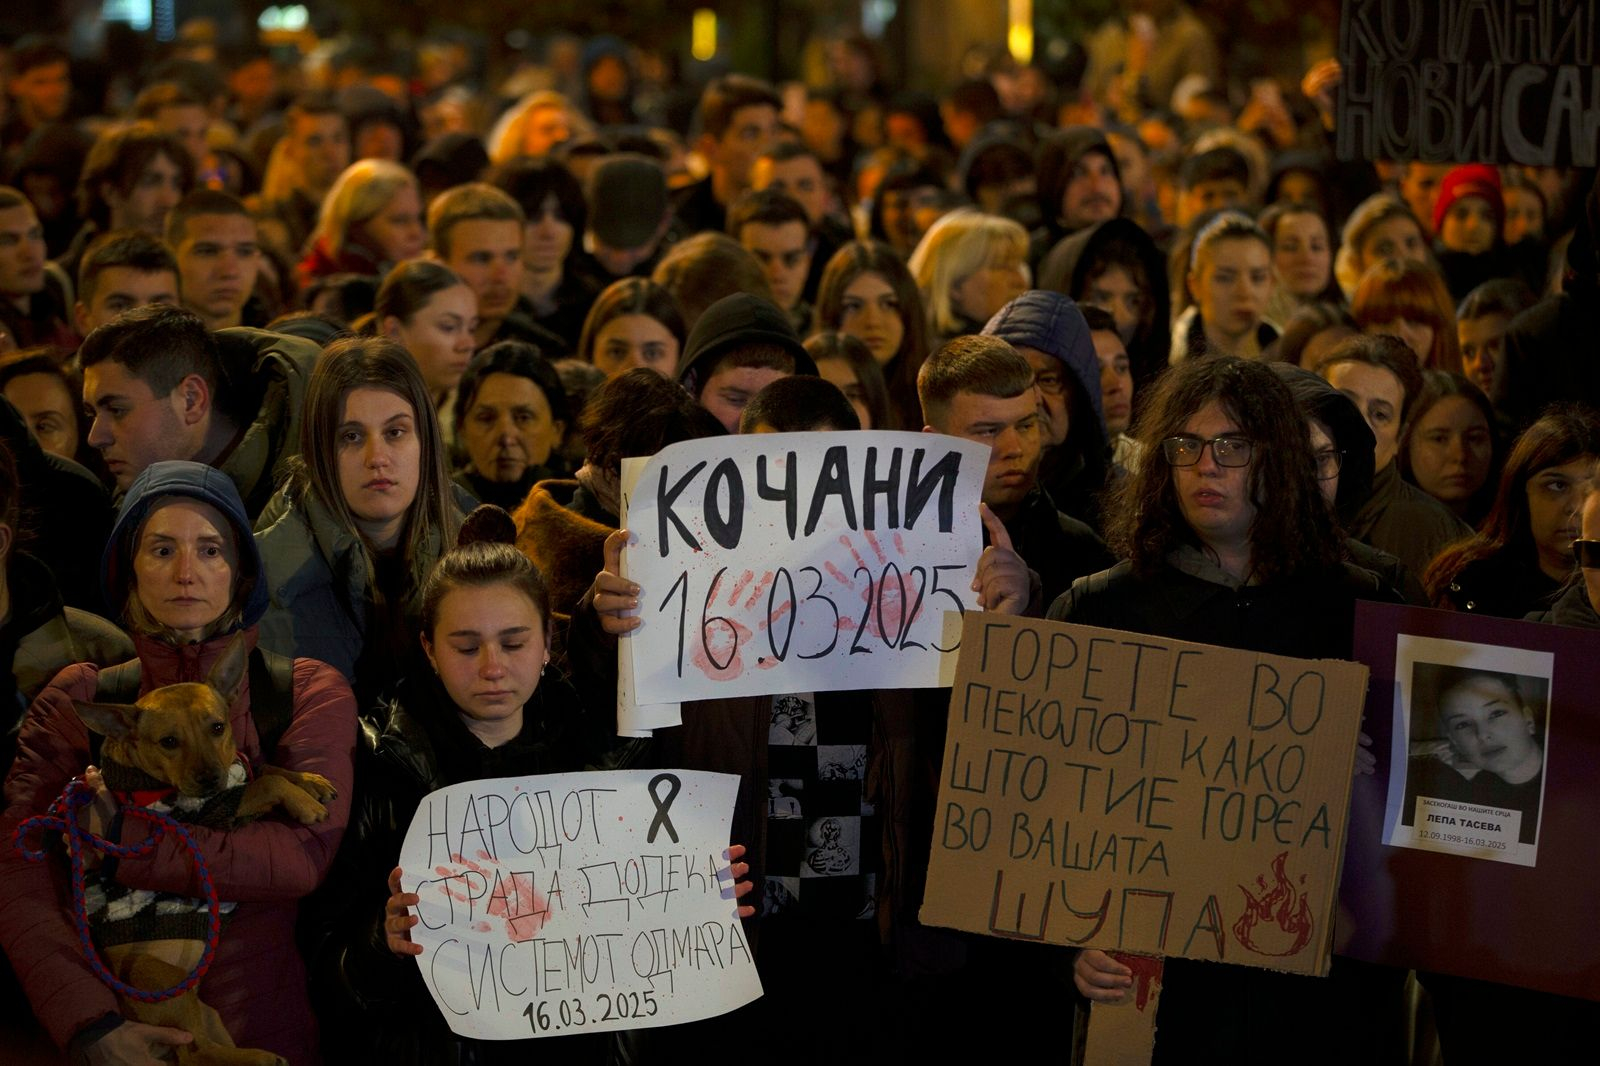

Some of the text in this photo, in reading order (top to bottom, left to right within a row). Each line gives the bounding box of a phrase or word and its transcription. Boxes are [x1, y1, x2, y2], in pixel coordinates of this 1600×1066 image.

[1336, 59, 1501, 163] НОВИ
[657, 445, 963, 558] КОЧАНИ
[981, 623, 1325, 736] ГОРЕТЕ ВО
[964, 682, 1306, 794] ПЕКОЛОТ КАКО
[428, 789, 618, 869] НАРОДОТ
[950, 742, 1331, 849] ШТО ТИЕ ГОРЕА
[1427, 814, 1502, 833] ЛЕПА ТАСЕВА
[1458, 804, 1468, 812] ВО
[1468, 806, 1494, 815] НАШИТЕ
[942, 802, 1170, 877] ВО ВАШАТА
[1419, 829, 1507, 850] 12.09.1998-16.03.2025
[415, 854, 723, 935] СТРАДА ДОДЕКА
[989, 869, 1225, 960] ШУПА
[431, 921, 751, 1016] СИСТЕМОТ ОДМАРА
[522, 990, 658, 1034] 16.03.2025
